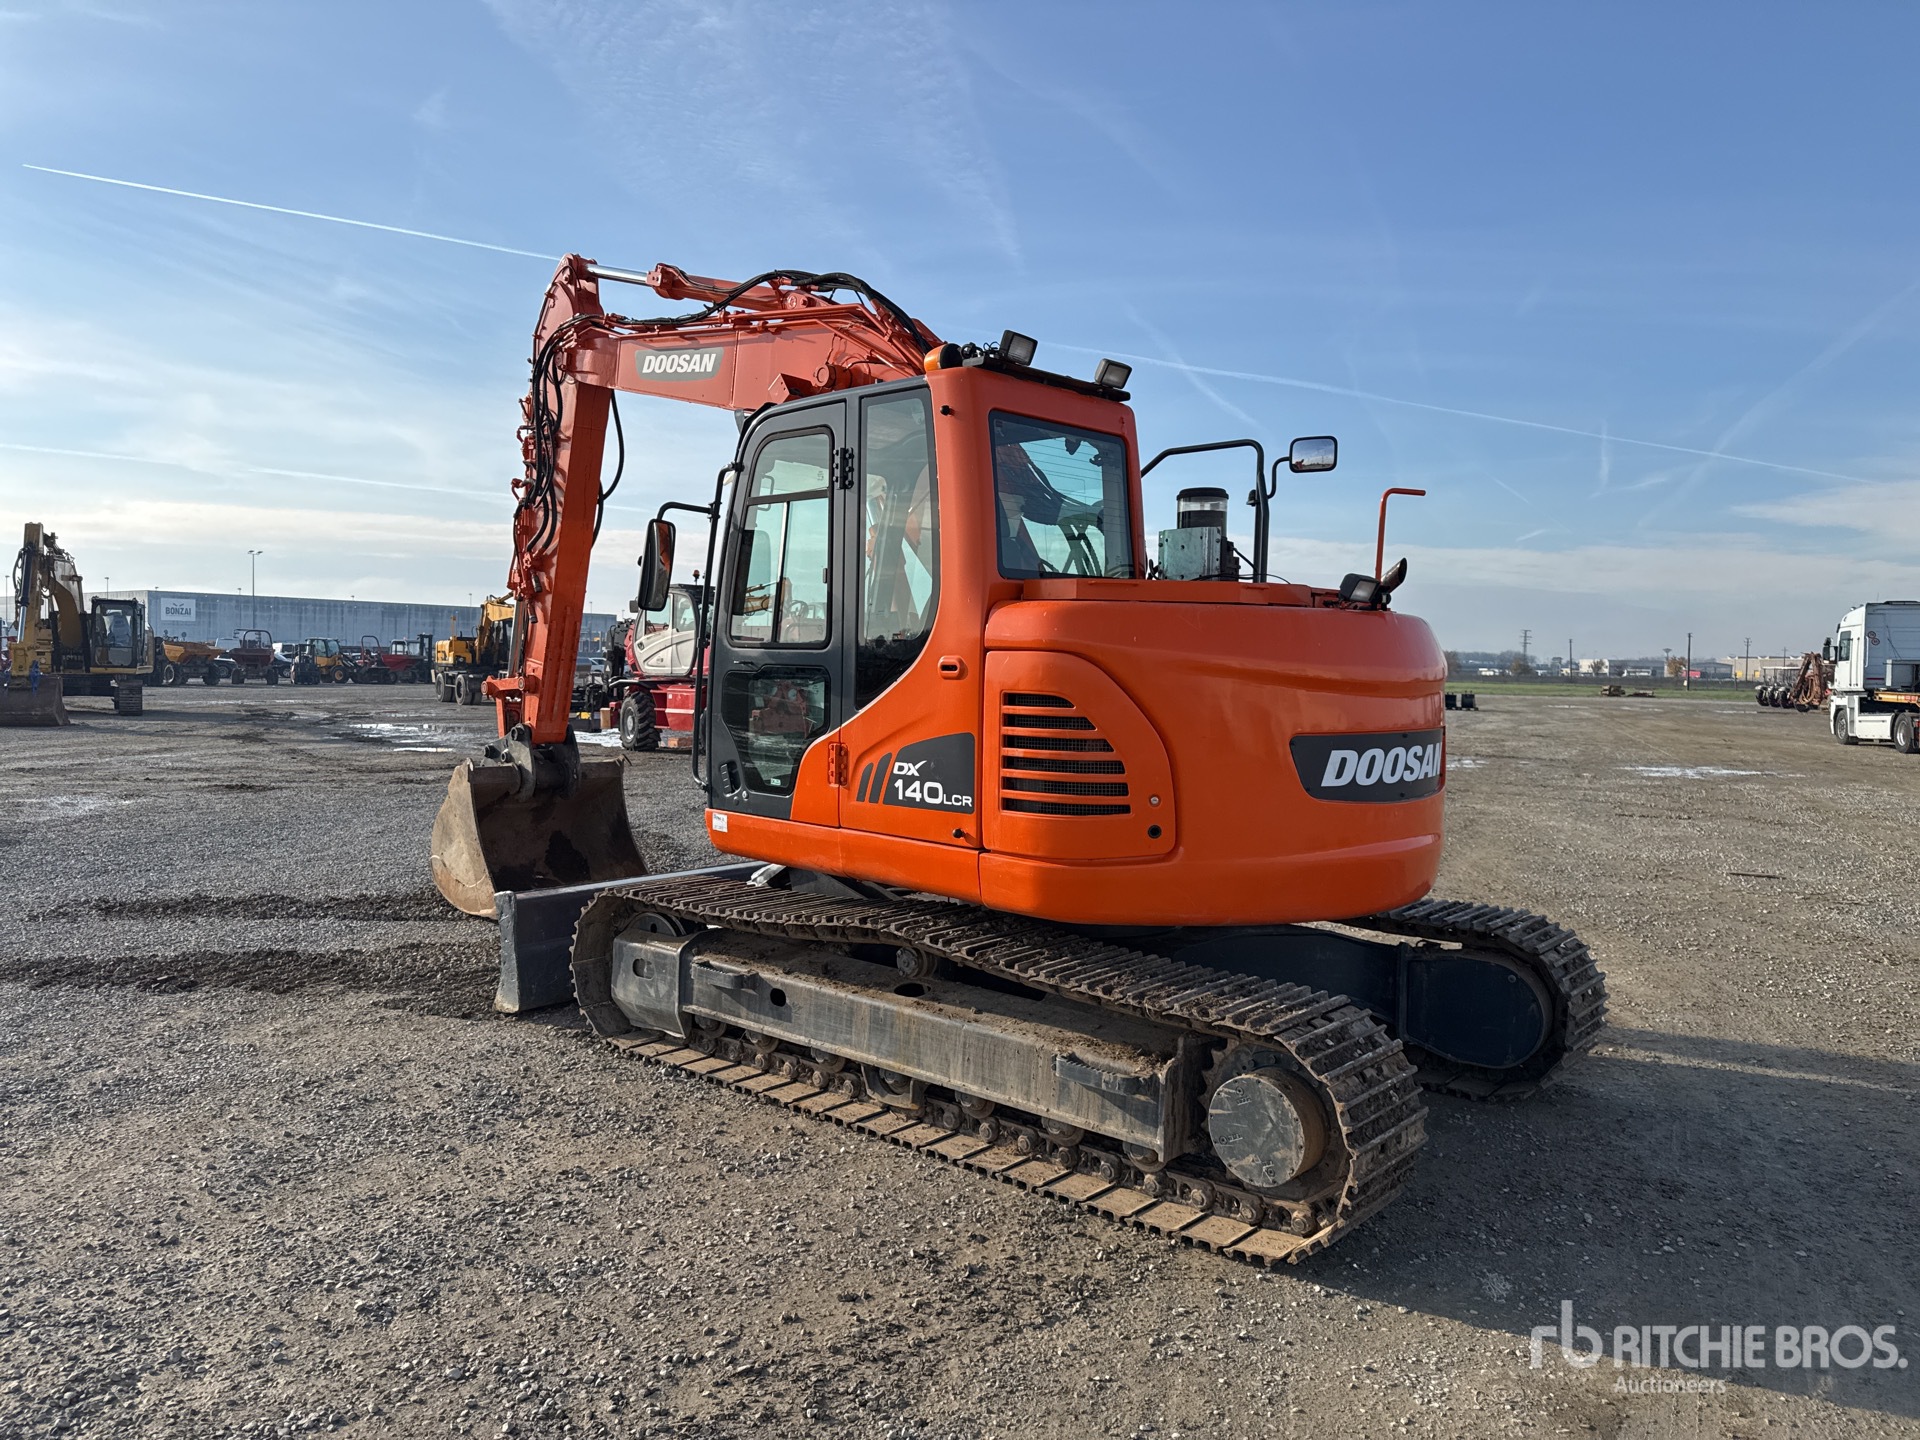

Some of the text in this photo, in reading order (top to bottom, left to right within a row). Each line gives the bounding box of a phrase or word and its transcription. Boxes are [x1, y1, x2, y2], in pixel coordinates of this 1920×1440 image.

[642, 353, 716, 374] DOOSAN
[165, 606, 192, 616] BONZAI
[893, 760, 927, 776] DX
[1321, 742, 1442, 787] DOOSAN
